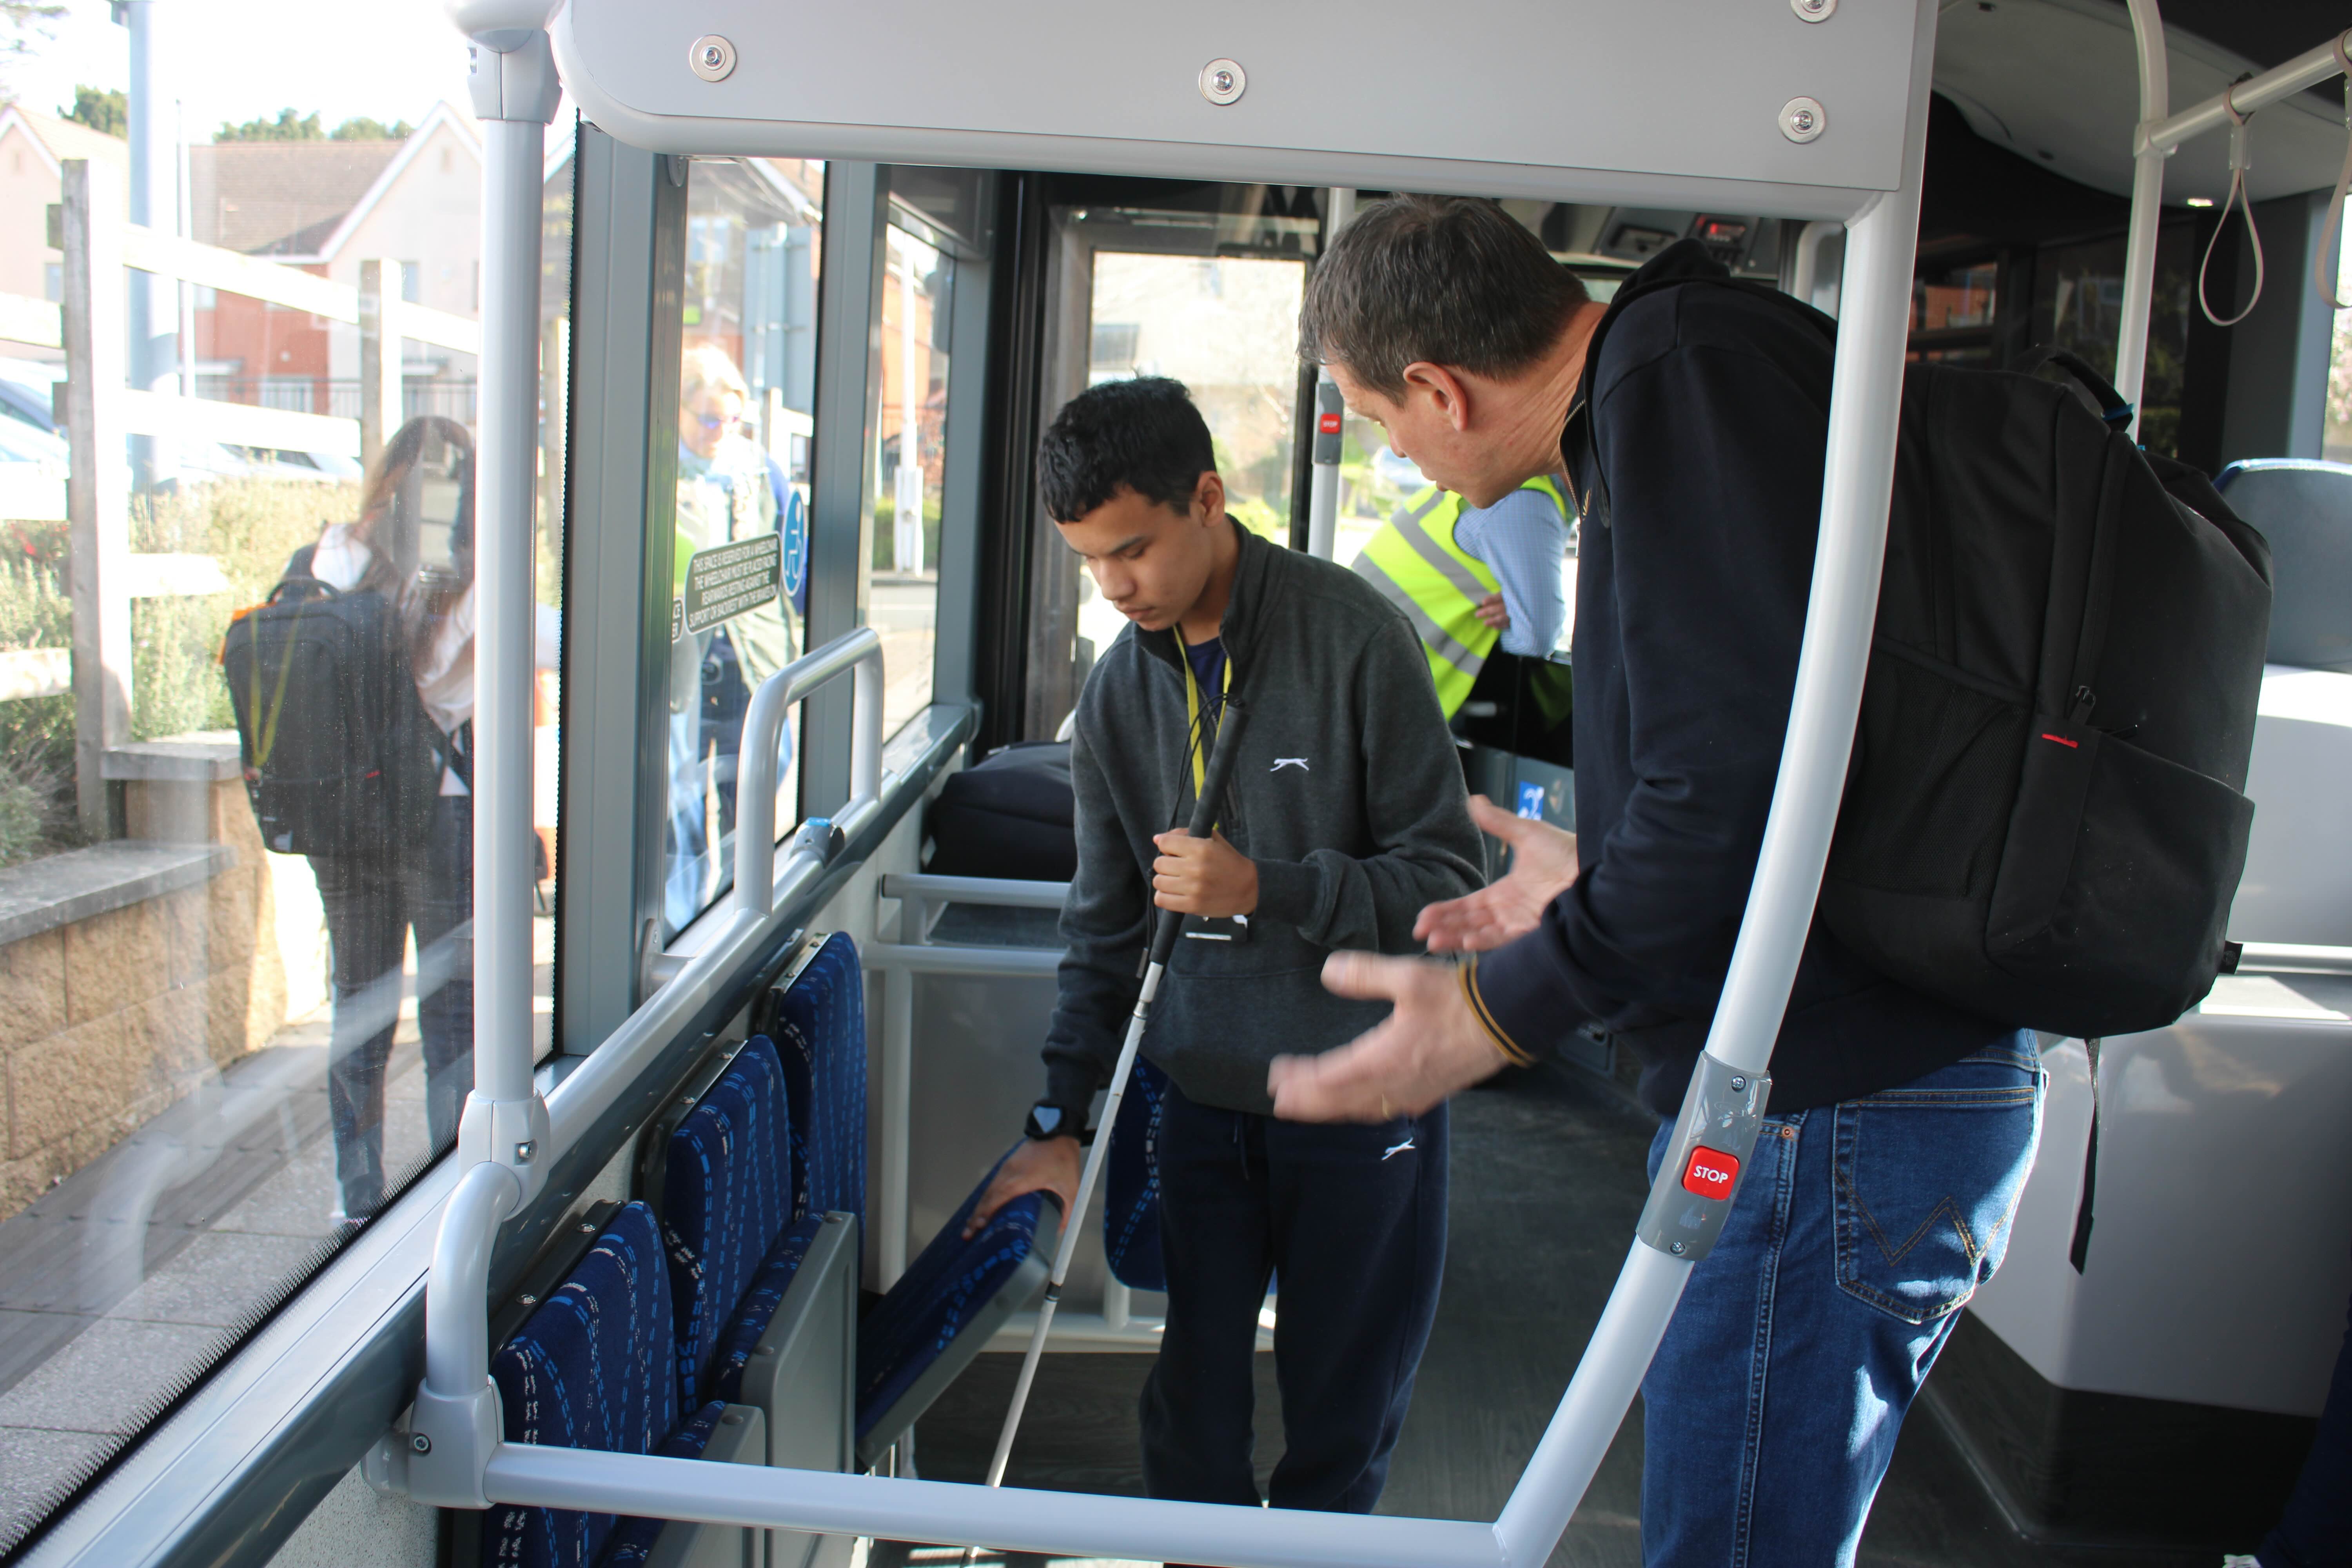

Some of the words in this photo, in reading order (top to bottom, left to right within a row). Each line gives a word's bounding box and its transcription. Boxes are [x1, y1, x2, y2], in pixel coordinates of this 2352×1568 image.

[693, 556, 704, 574] THIS
[703, 553, 718, 572] SPACE
[721, 547, 742, 566] RESERVED
[742, 544, 750, 561] FOR
[693, 573, 704, 592] THE
[704, 566, 731, 588] WHEELCHAIR
[731, 562, 742, 580] MUST
[748, 556, 763, 574] PLACED
[763, 552, 777, 570] FACING
[701, 583, 728, 607] REARWARDS
[728, 577, 745, 597] RESTING
[745, 572, 762, 591] AGAINST
[762, 569, 770, 585] THE
[688, 606, 710, 630] SUPPORT
[717, 596, 738, 618] BACKREST
[738, 592, 748, 610] WITH
[748, 589, 756, 606] THE
[1693, 1165, 1728, 1184] STOP
